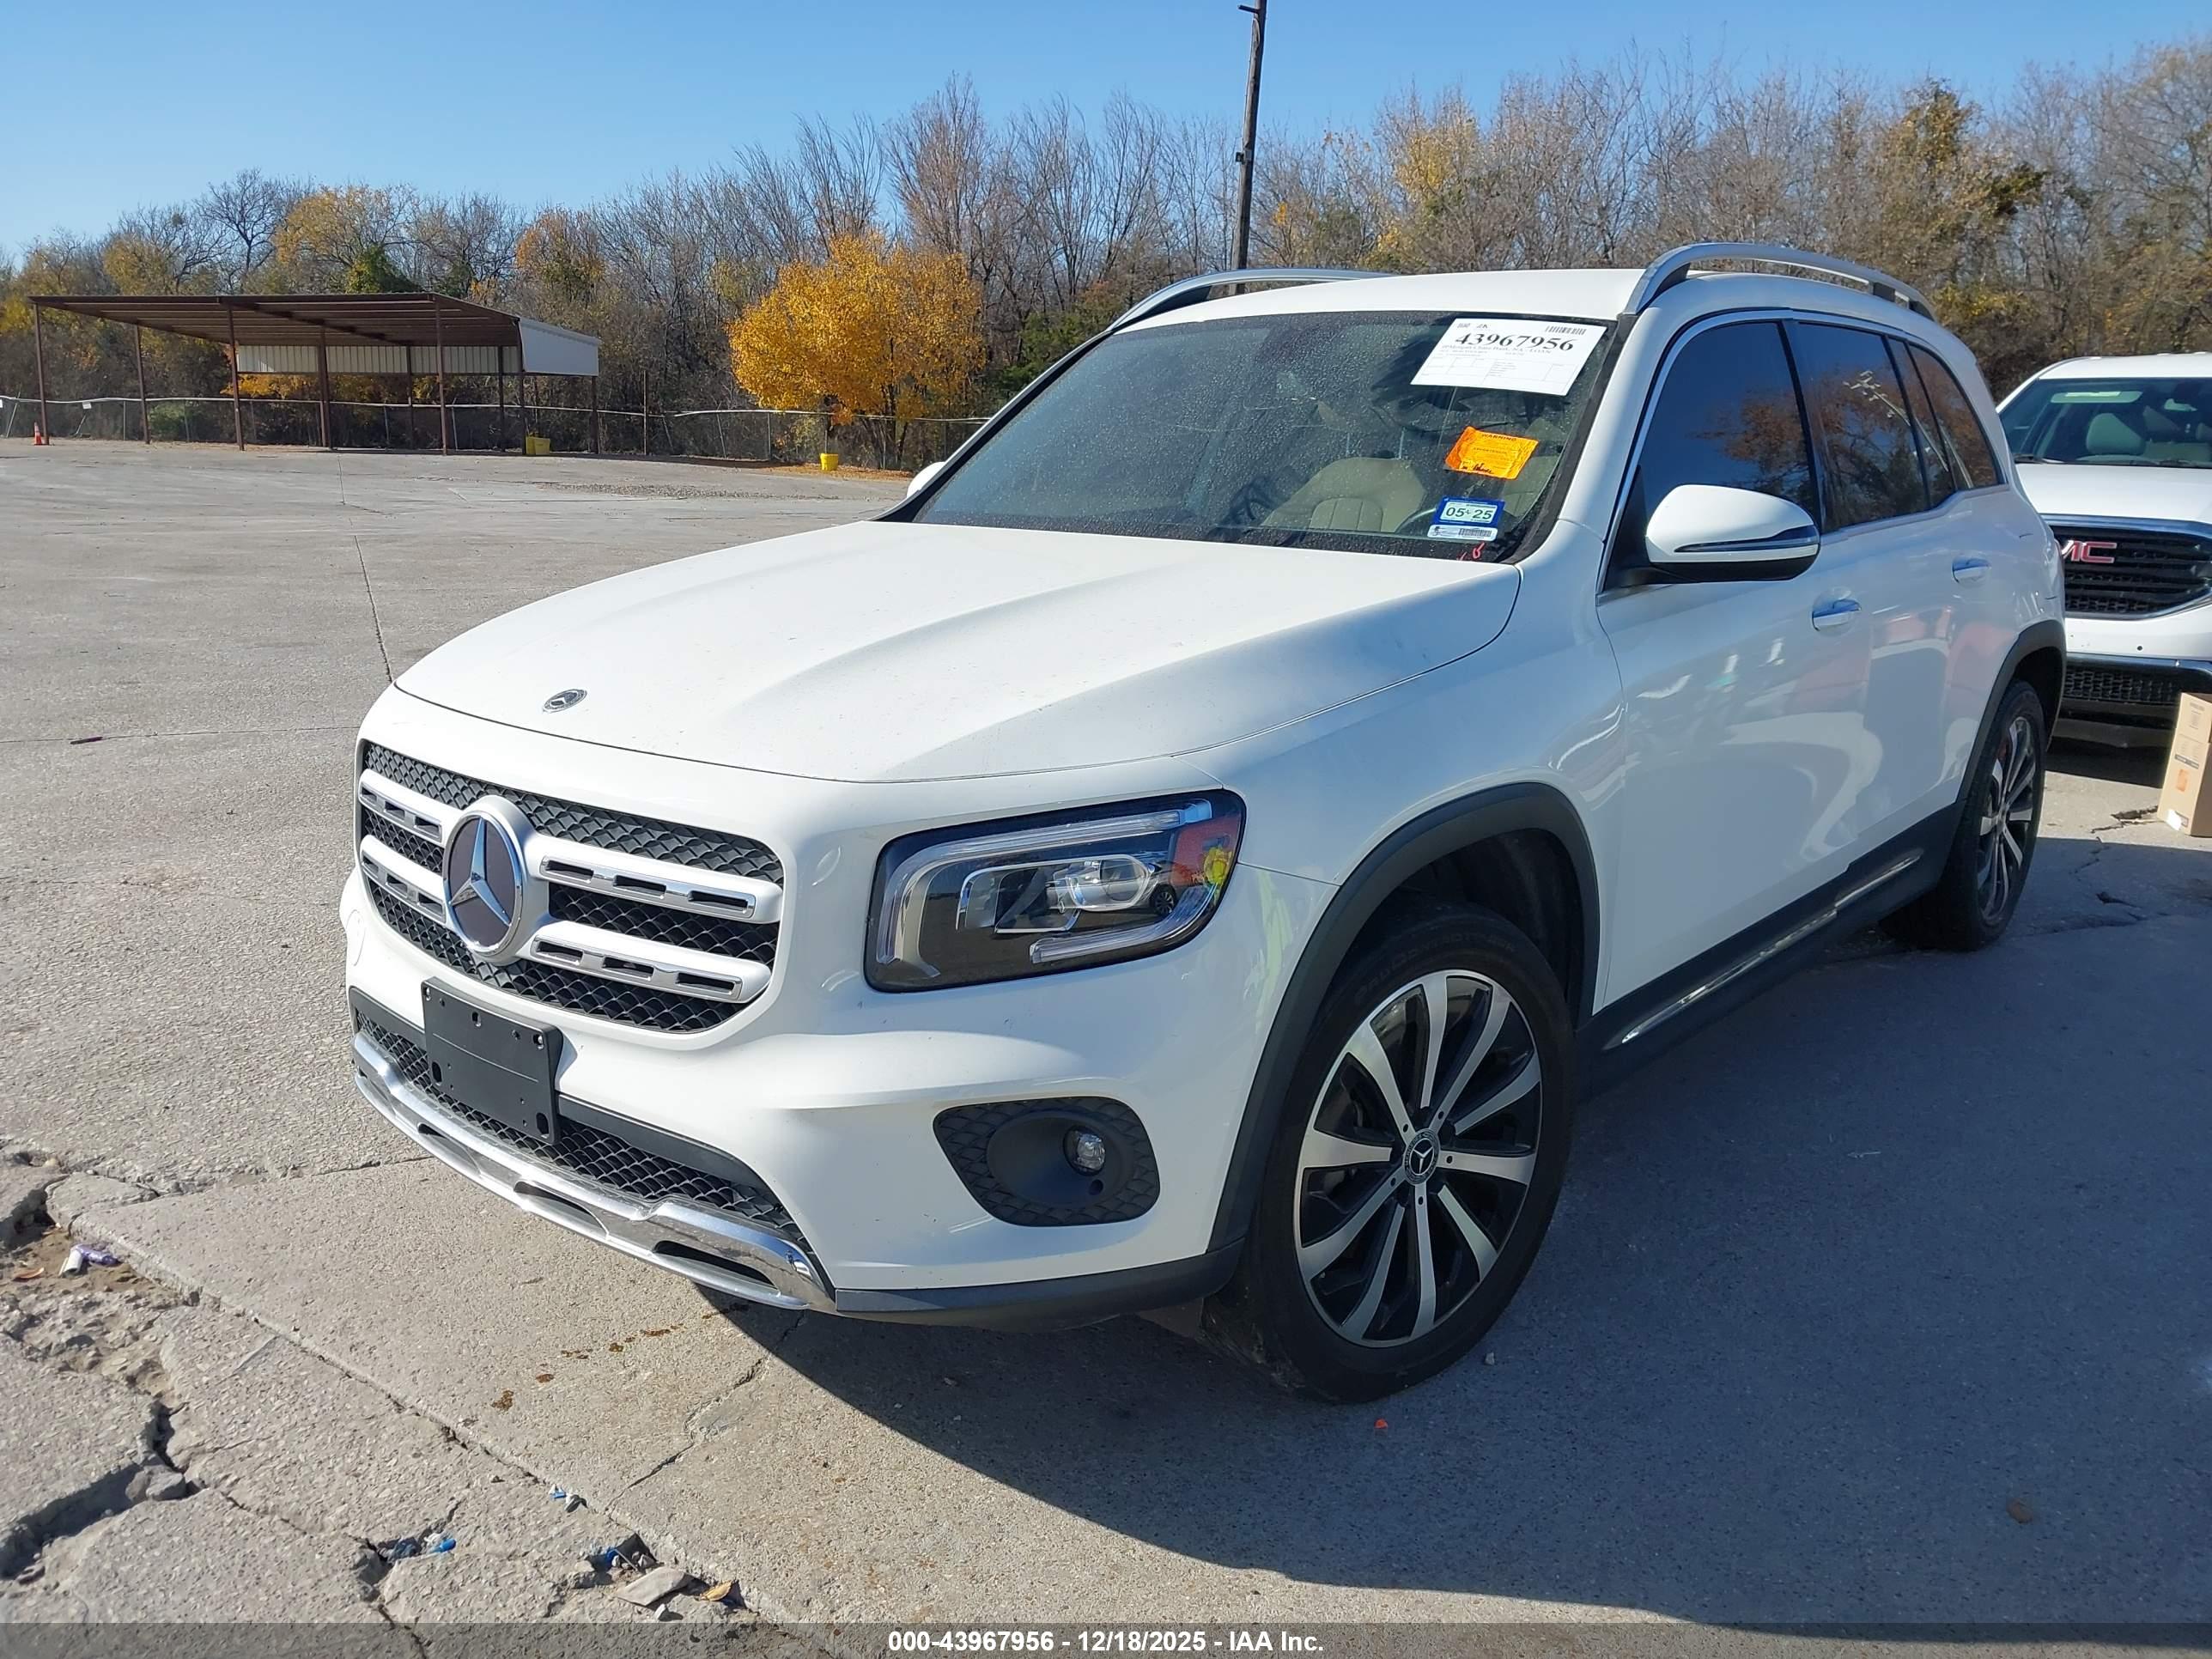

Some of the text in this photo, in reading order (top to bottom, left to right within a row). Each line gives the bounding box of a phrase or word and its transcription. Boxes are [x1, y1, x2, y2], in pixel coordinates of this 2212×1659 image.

[1455, 332, 1578, 351] 43967956
[1446, 507, 1493, 520] 05 25
[2062, 539, 2118, 563] MC
